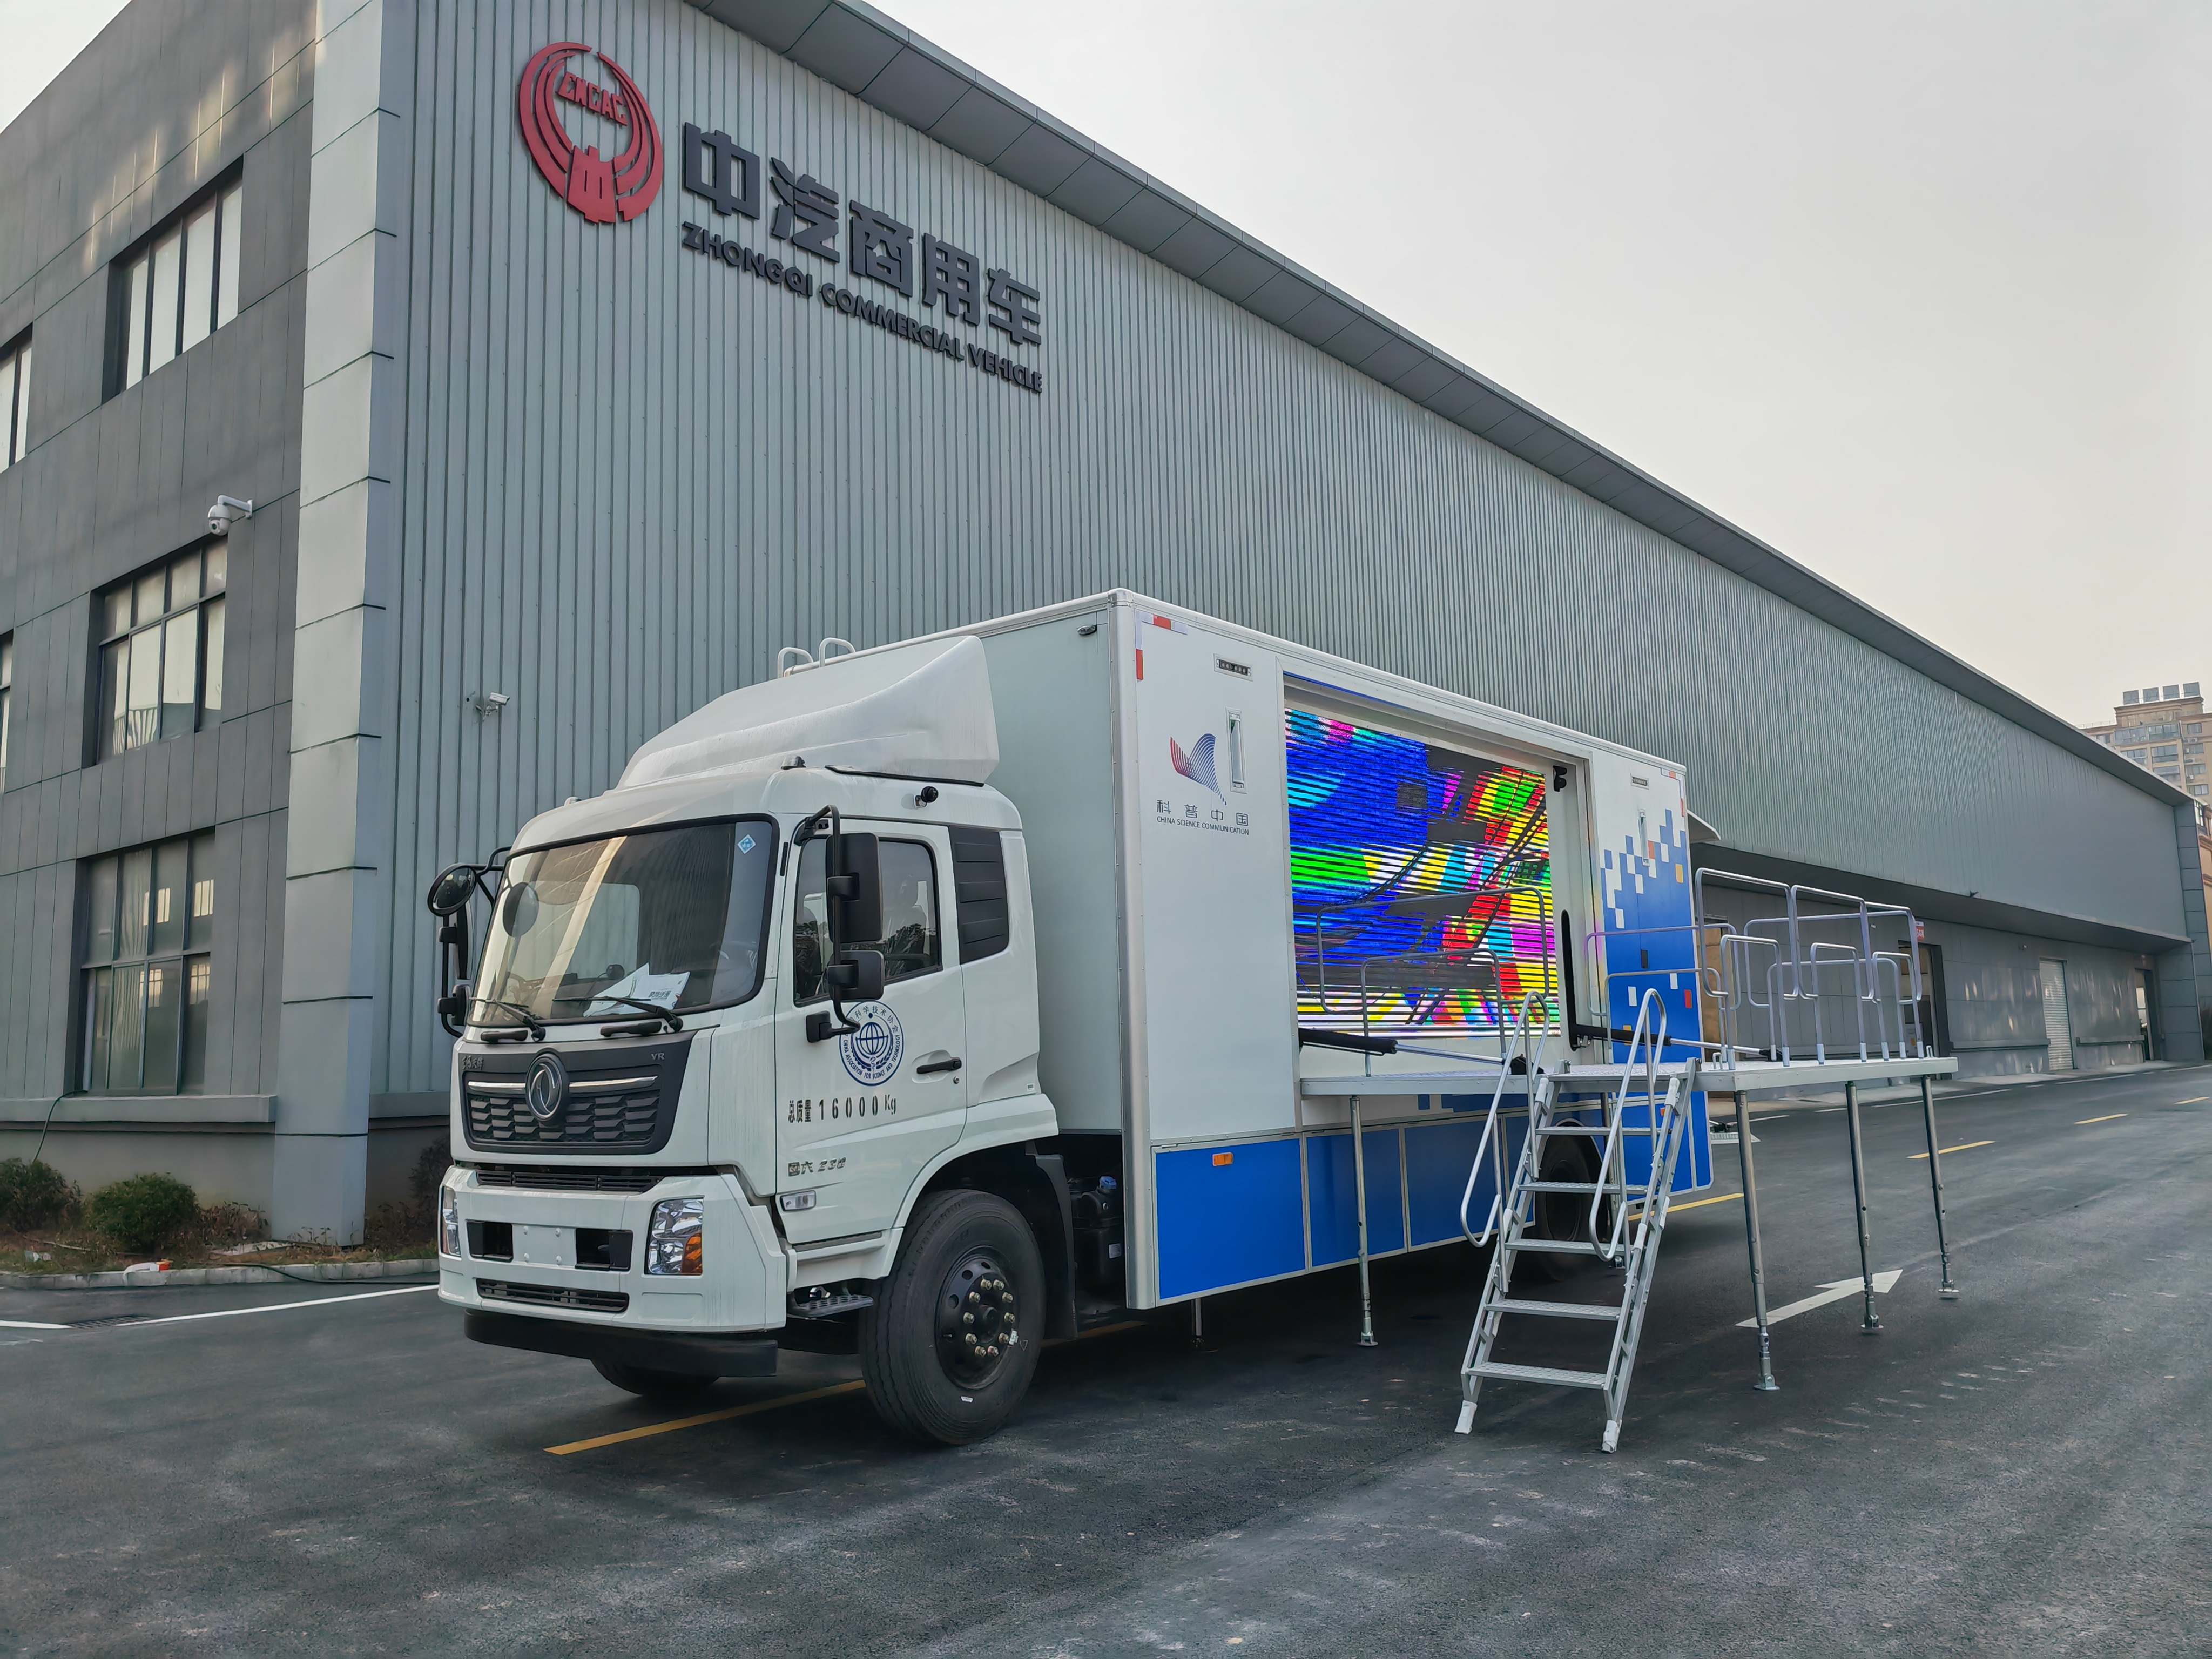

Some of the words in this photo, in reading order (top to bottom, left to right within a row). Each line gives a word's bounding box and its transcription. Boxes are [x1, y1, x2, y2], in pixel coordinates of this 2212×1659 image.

[684, 122, 1041, 346] 中汽商用车
[682, 221, 813, 298] ZHONGQI
[820, 282, 965, 361] COMMERCIAL
[968, 343, 1043, 394] VEHICLE
[1156, 799, 1249, 827] 科普中国
[1156, 815, 1176, 825] CHINA
[1177, 819, 1200, 828] SCIENCE
[1201, 822, 1249, 836] COMMUNICATION
[848, 1004, 899, 1034] 科学技术协会
[651, 1053, 665, 1061] VR
[845, 1054, 863, 1076] ASSOCIATION
[872, 1070, 886, 1080] SCIENCE
[885, 1062, 893, 1073] AND
[788, 1099, 812, 1123] 总质量
[819, 1095, 878, 1121] 16000
